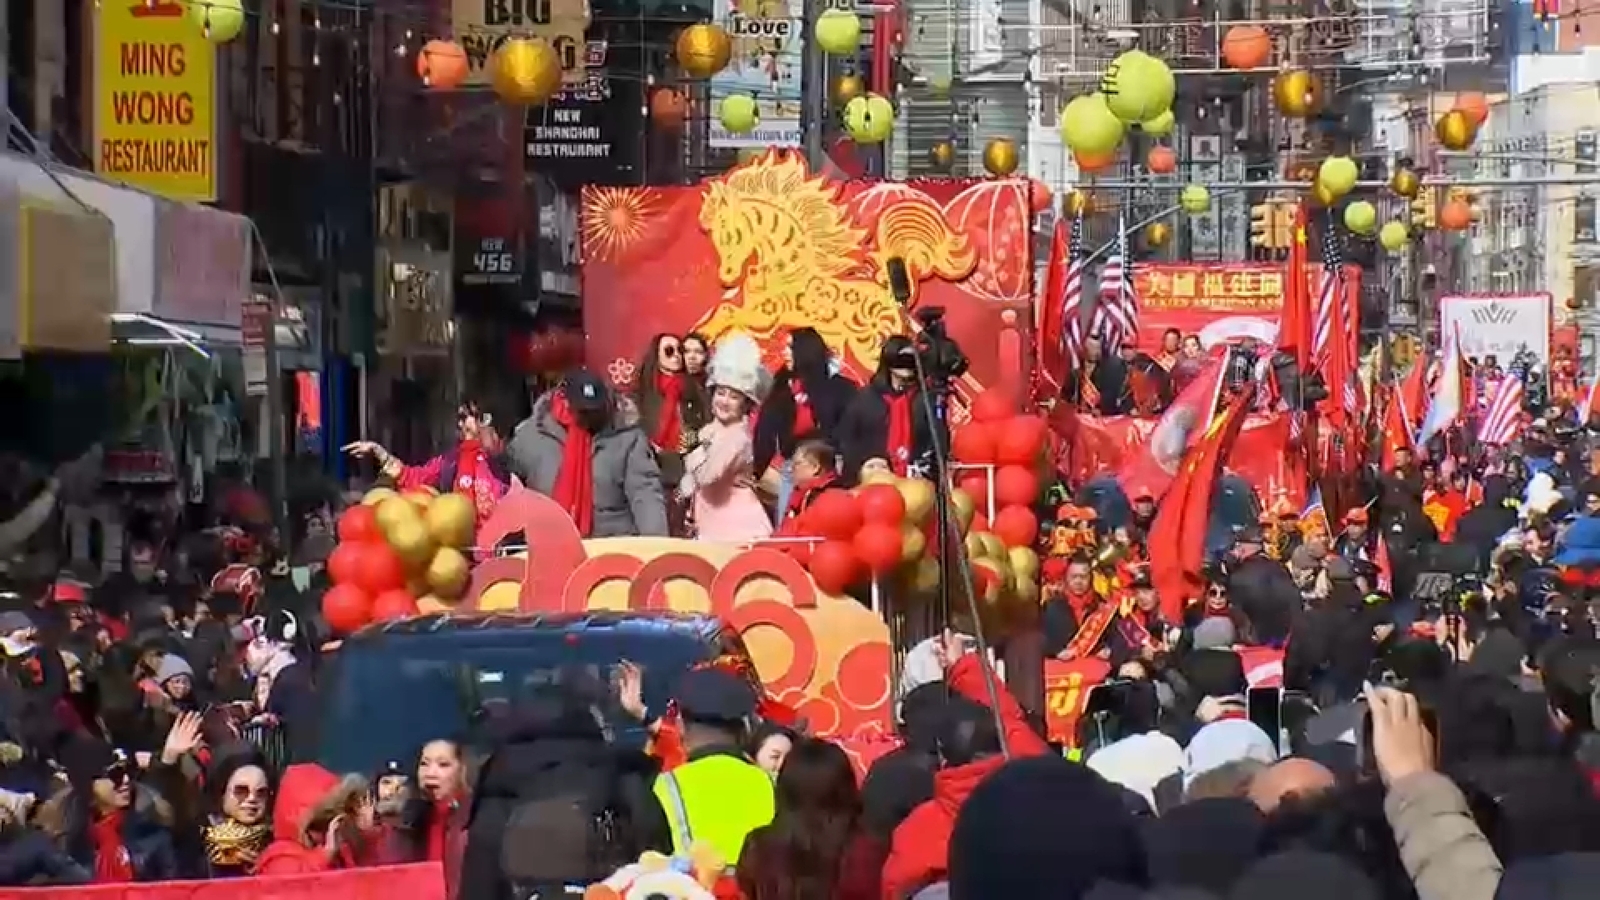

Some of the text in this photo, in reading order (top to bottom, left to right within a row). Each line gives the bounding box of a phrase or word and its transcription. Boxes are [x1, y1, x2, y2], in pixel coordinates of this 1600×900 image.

[485, 0, 552, 25] BIG
[734, 16, 789, 35] Love
[120, 41, 186, 77] MING
[462, 35, 576, 71] WG
[112, 91, 194, 125] WONG
[554, 110, 581, 123] NEW
[535, 126, 600, 140] SHANGHAI
[101, 138, 208, 177] RESTAURANT
[527, 143, 611, 157] RESTAURANT
[473, 252, 513, 272] 456
